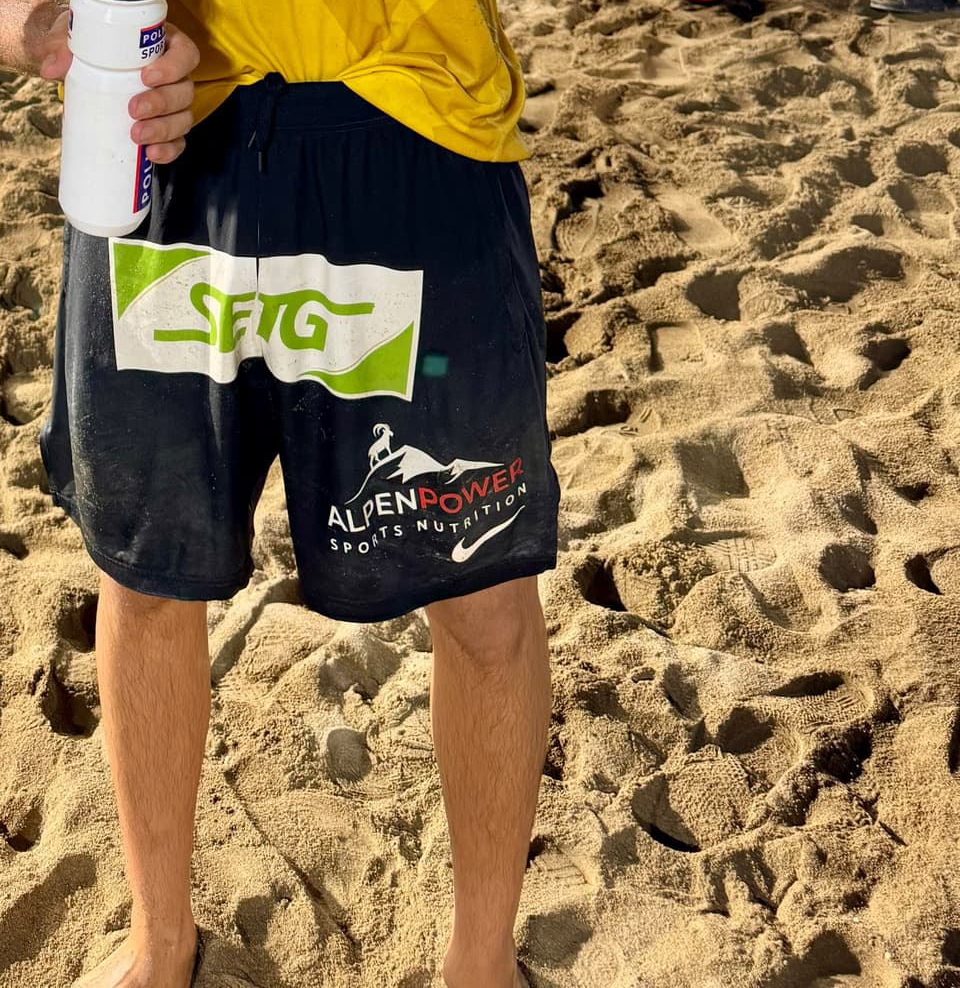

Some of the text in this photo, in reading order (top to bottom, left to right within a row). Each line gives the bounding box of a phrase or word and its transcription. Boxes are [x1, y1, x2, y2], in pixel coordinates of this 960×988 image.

[141, 157, 152, 204] POL
[330, 482, 527, 555] SPORTS NUTRITION
